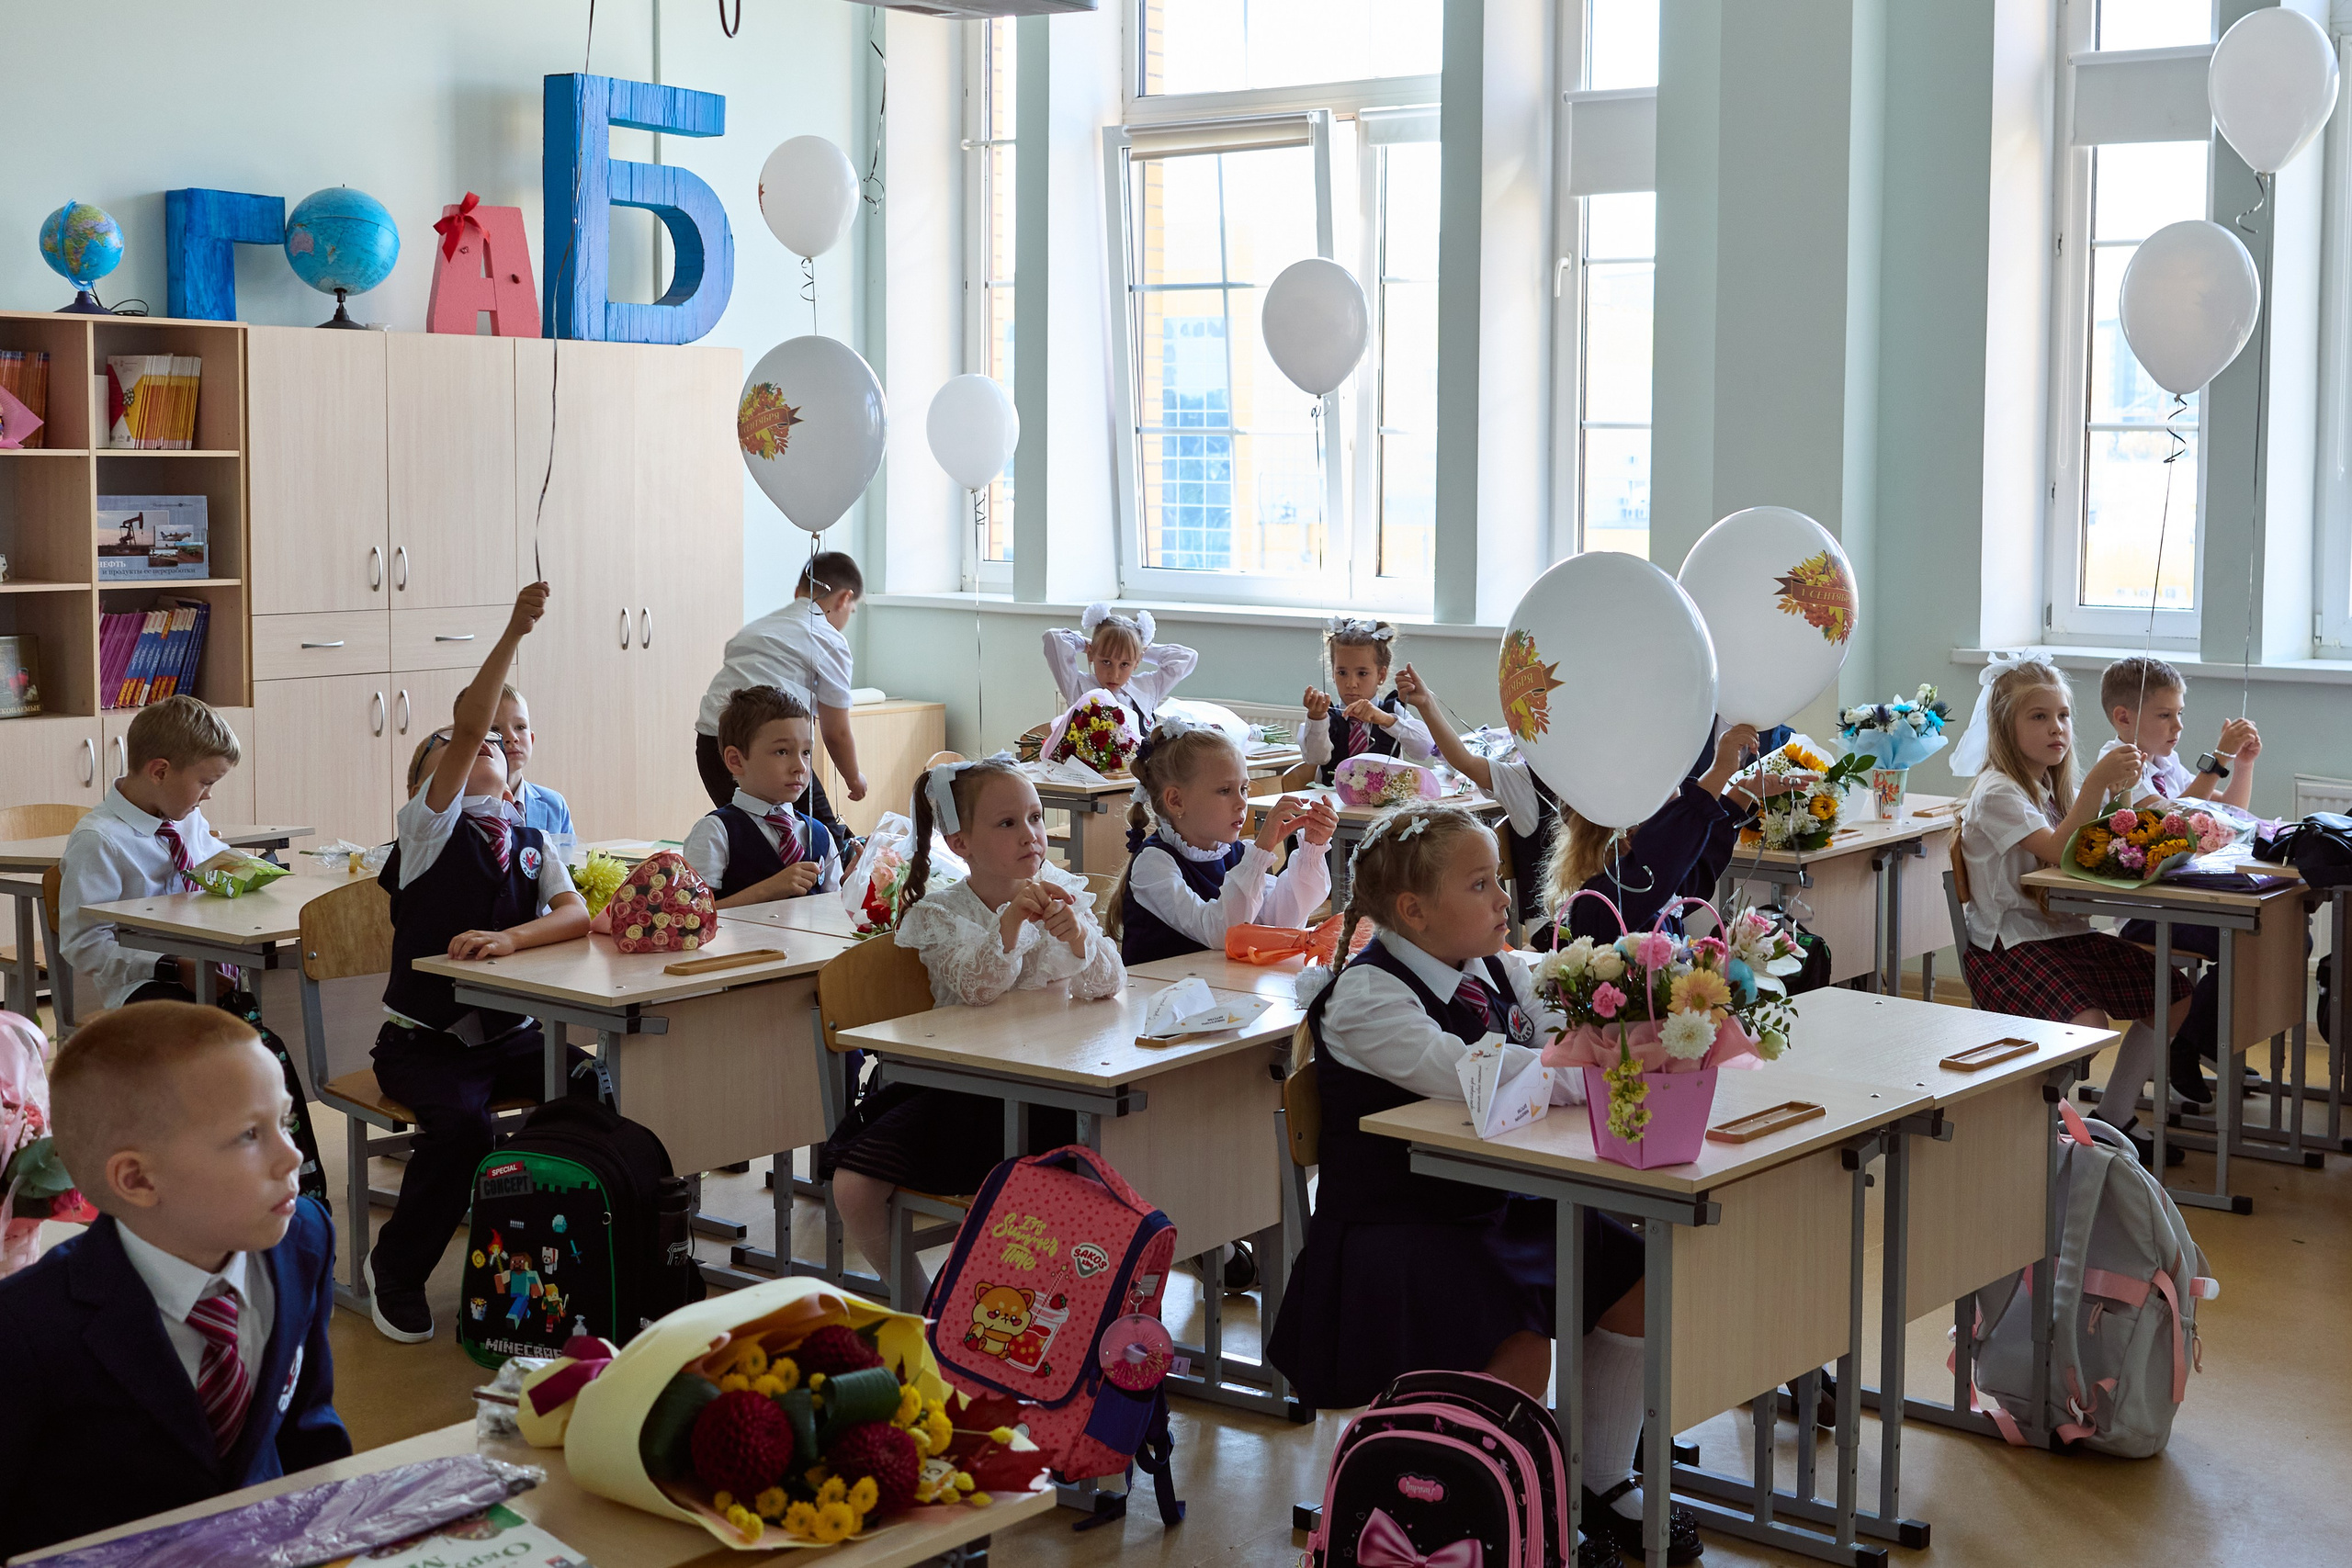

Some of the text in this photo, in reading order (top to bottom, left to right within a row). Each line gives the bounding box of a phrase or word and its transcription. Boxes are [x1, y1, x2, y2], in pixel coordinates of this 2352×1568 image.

[543, 73, 735, 345] Б
[426, 204, 542, 337] А
[1810, 590, 1850, 604] СЕНТЯБР
[0, 705, 41, 714] КОПАЕМЫЕ
[492, 1164, 518, 1177] SPECIAL
[483, 1175, 529, 1197] CONCEPT
[992, 1213, 1058, 1258] Summer
[1073, 1248, 1108, 1269] SAKOS
[485, 1337, 563, 1359] MINECRAF
